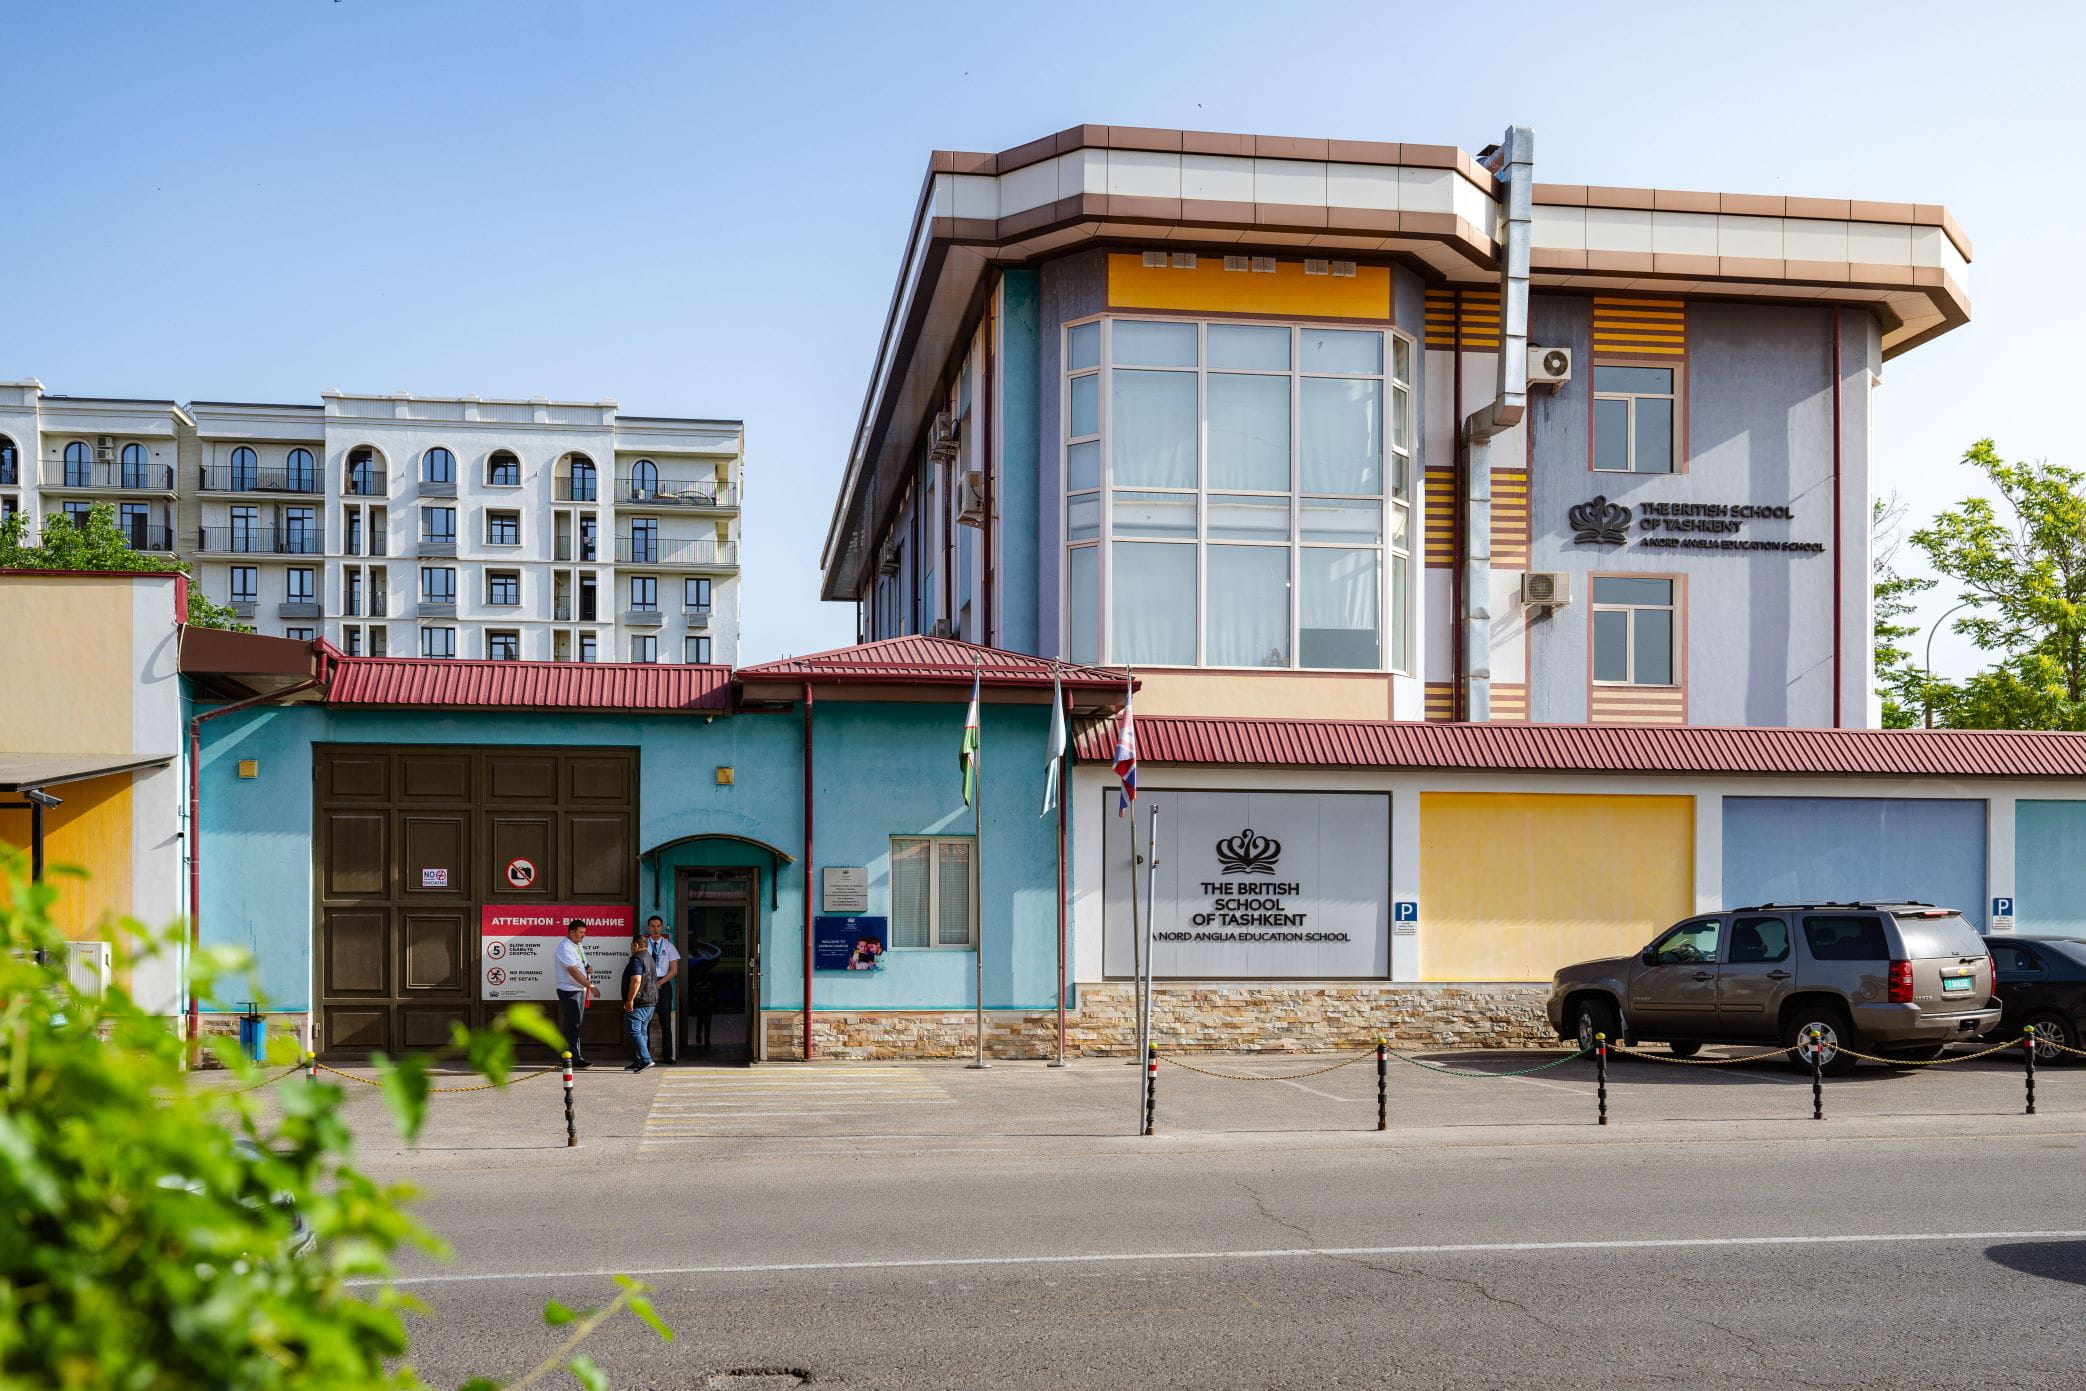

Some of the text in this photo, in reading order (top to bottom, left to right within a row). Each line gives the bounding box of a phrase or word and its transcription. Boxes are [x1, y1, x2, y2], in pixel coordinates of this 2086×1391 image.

[1640, 502, 1794, 520] THE BRITISH SCHOOL
[1640, 518, 1743, 533] OF TASHKENT
[1640, 538, 1826, 552] A NORD ANGLIA EDUCATION SCHOOL
[1201, 882, 1300, 896] THE BRITISH
[1214, 898, 1285, 911] SCHOOL
[1998, 899, 2009, 916] P
[1401, 903, 1413, 921] P
[492, 917, 554, 926] ATTENTION
[1193, 914, 1307, 926] OF TASHKENT
[1159, 932, 1192, 942] NORD
[1194, 932, 1236, 942] ANGLIA
[1238, 932, 1303, 942] EDUCATION
[1305, 932, 1351, 942] SCHOOL
[493, 946, 500, 956] 5
